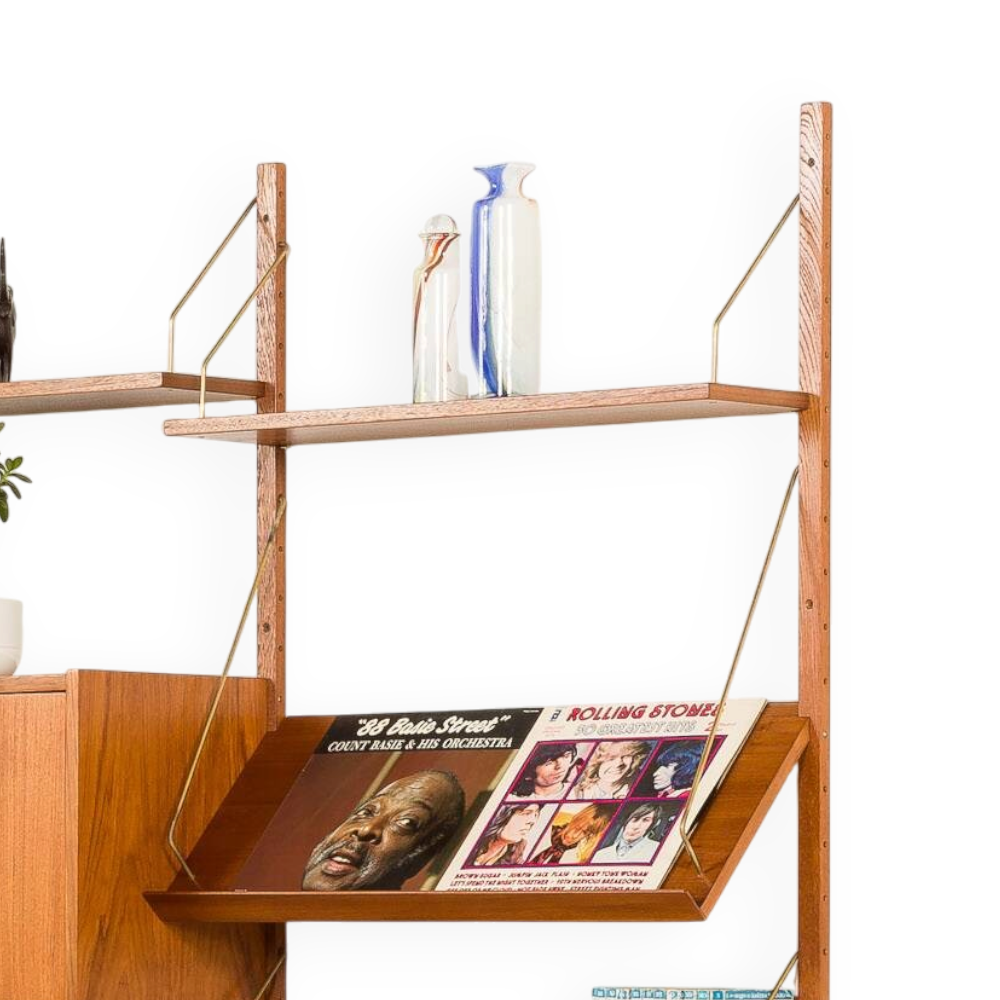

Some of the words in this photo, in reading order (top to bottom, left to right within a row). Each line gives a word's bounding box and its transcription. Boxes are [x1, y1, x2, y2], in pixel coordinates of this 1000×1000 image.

[566, 705, 648, 722] ROLLING
[386, 717, 437, 736] Basie
[327, 740, 371, 752] COUNT
[369, 739, 405, 751] BASIE
[405, 739, 416, 750] &
[416, 738, 441, 750] HIS
[442, 737, 514, 749] ORCHESTRA
